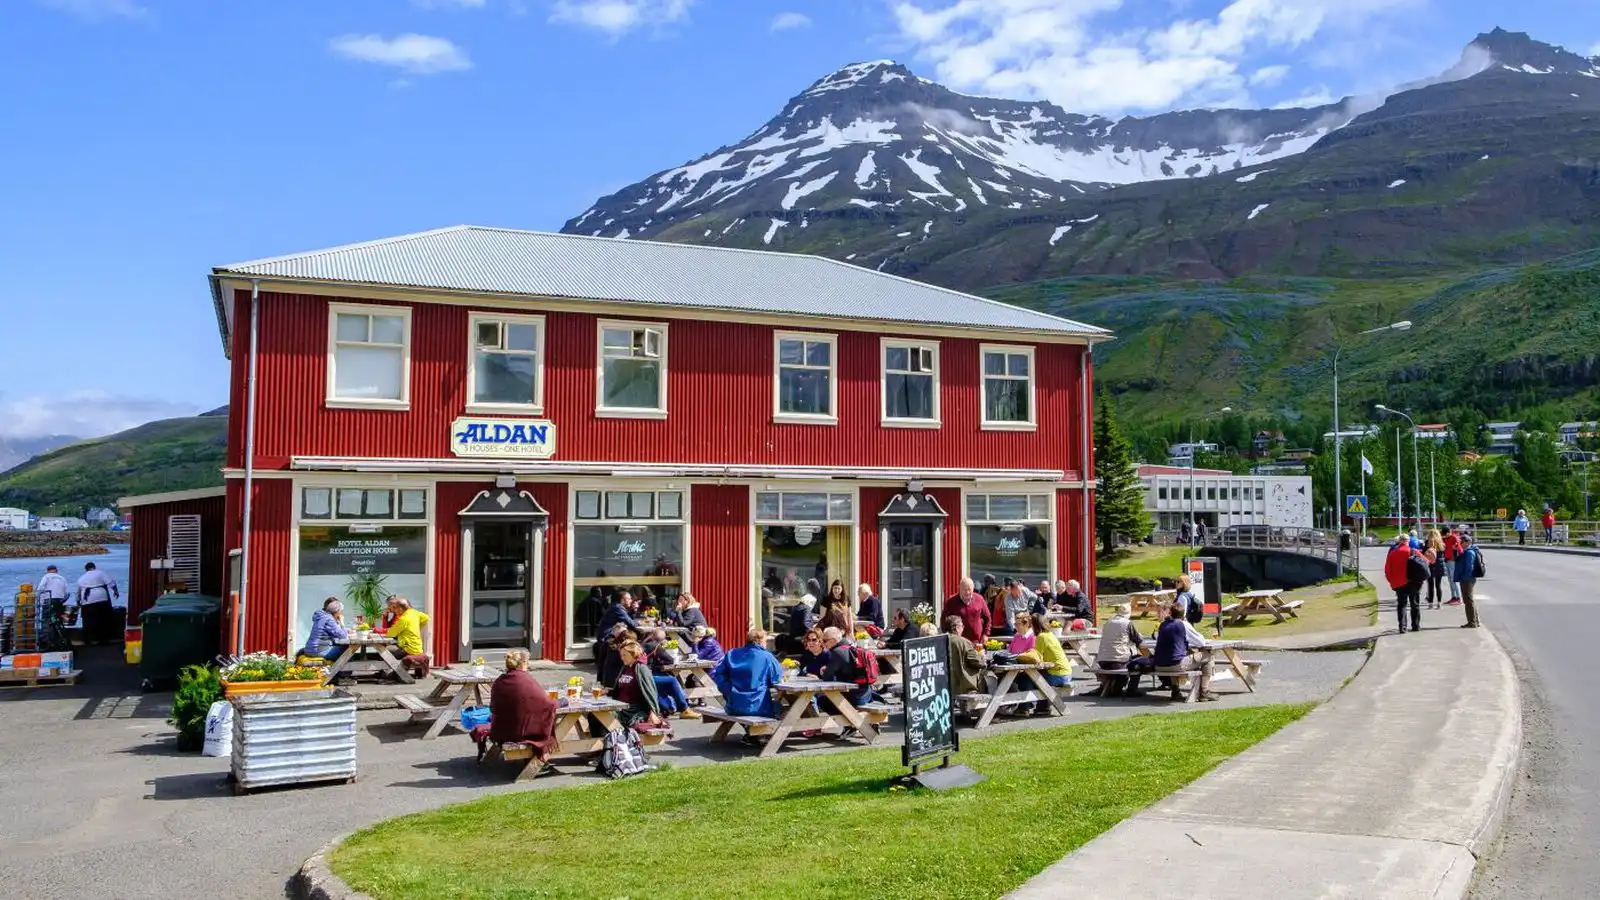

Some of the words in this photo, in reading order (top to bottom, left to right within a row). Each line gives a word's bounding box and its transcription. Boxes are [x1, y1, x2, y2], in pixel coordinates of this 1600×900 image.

[455, 423, 549, 444] ALDAN
[470, 444, 499, 453] HOUSES
[504, 445, 521, 453] ONE
[522, 445, 544, 454] HOTEL
[329, 547, 371, 555] RECEPTION
[911, 665, 924, 680] OF
[926, 661, 945, 677] THE
[910, 676, 936, 700] DAY
